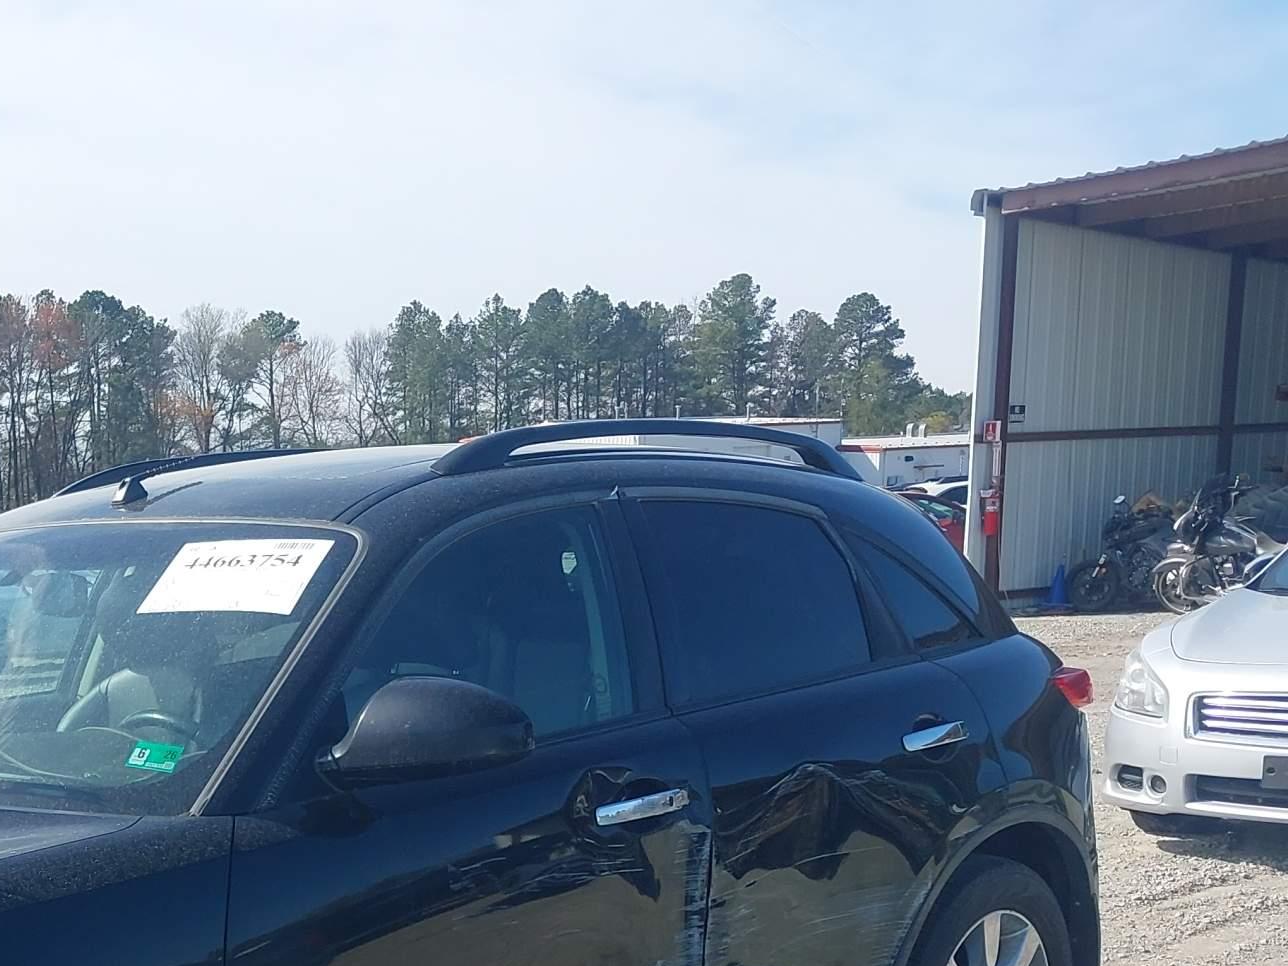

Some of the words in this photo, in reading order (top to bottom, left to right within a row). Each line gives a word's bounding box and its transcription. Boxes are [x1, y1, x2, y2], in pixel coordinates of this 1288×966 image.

[183, 553, 304, 570] 44663754
[137, 747, 148, 759] 6
[163, 750, 178, 760] 26
